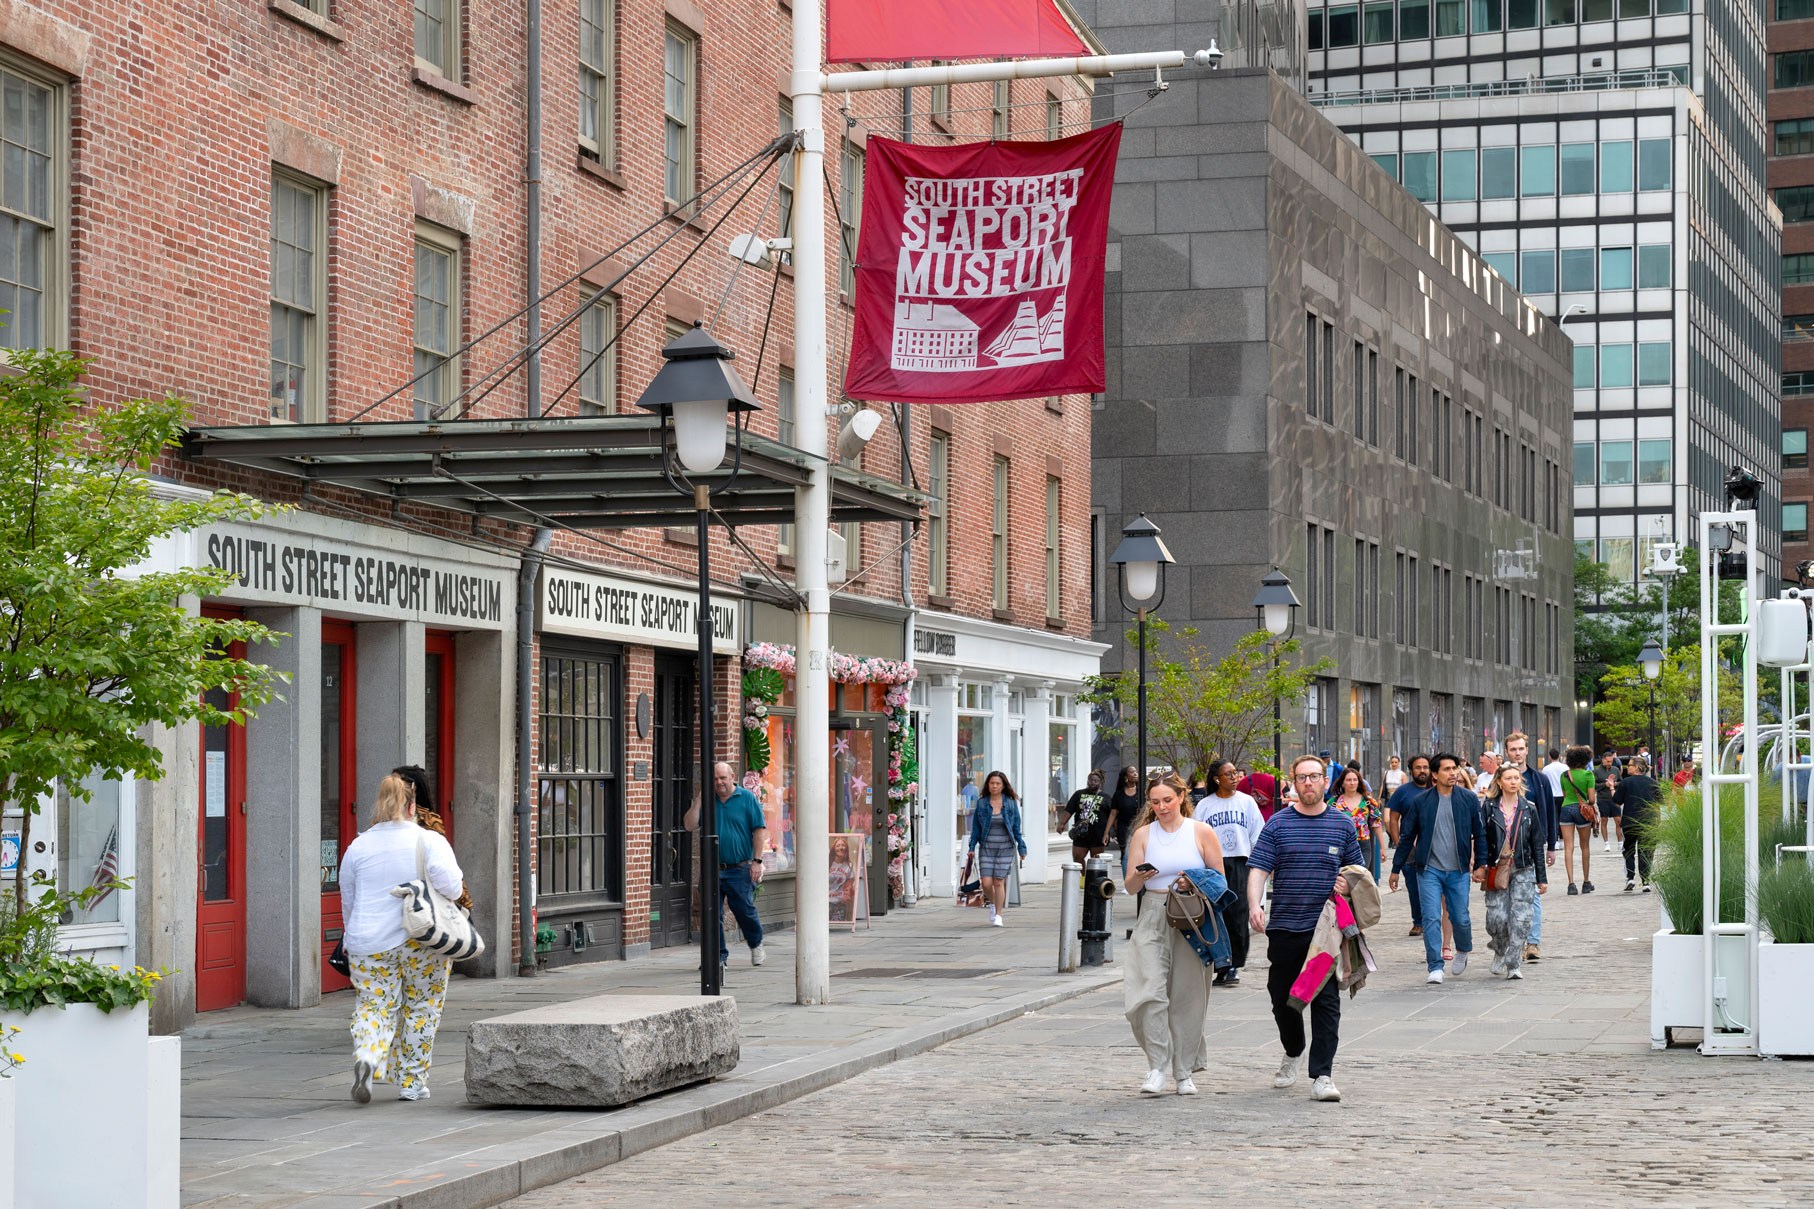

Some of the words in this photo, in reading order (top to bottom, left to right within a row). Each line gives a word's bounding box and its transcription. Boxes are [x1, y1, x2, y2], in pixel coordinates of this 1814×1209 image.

[904, 177, 985, 208] SOUTH
[991, 168, 1085, 207] STREET
[902, 205, 1072, 251] SEAPORT
[896, 237, 1073, 298] MUSEUM
[208, 533, 276, 592] SOUTH
[281, 546, 351, 601] STREET
[354, 556, 430, 611] SEAPORT
[434, 570, 501, 622] MUSEUM
[548, 577, 590, 619] SOUTH
[594, 585, 638, 627] STREET
[640, 592, 689, 633] SEAPORT
[693, 602, 734, 640] MSEUM
[914, 629, 936, 653] FELLOW
